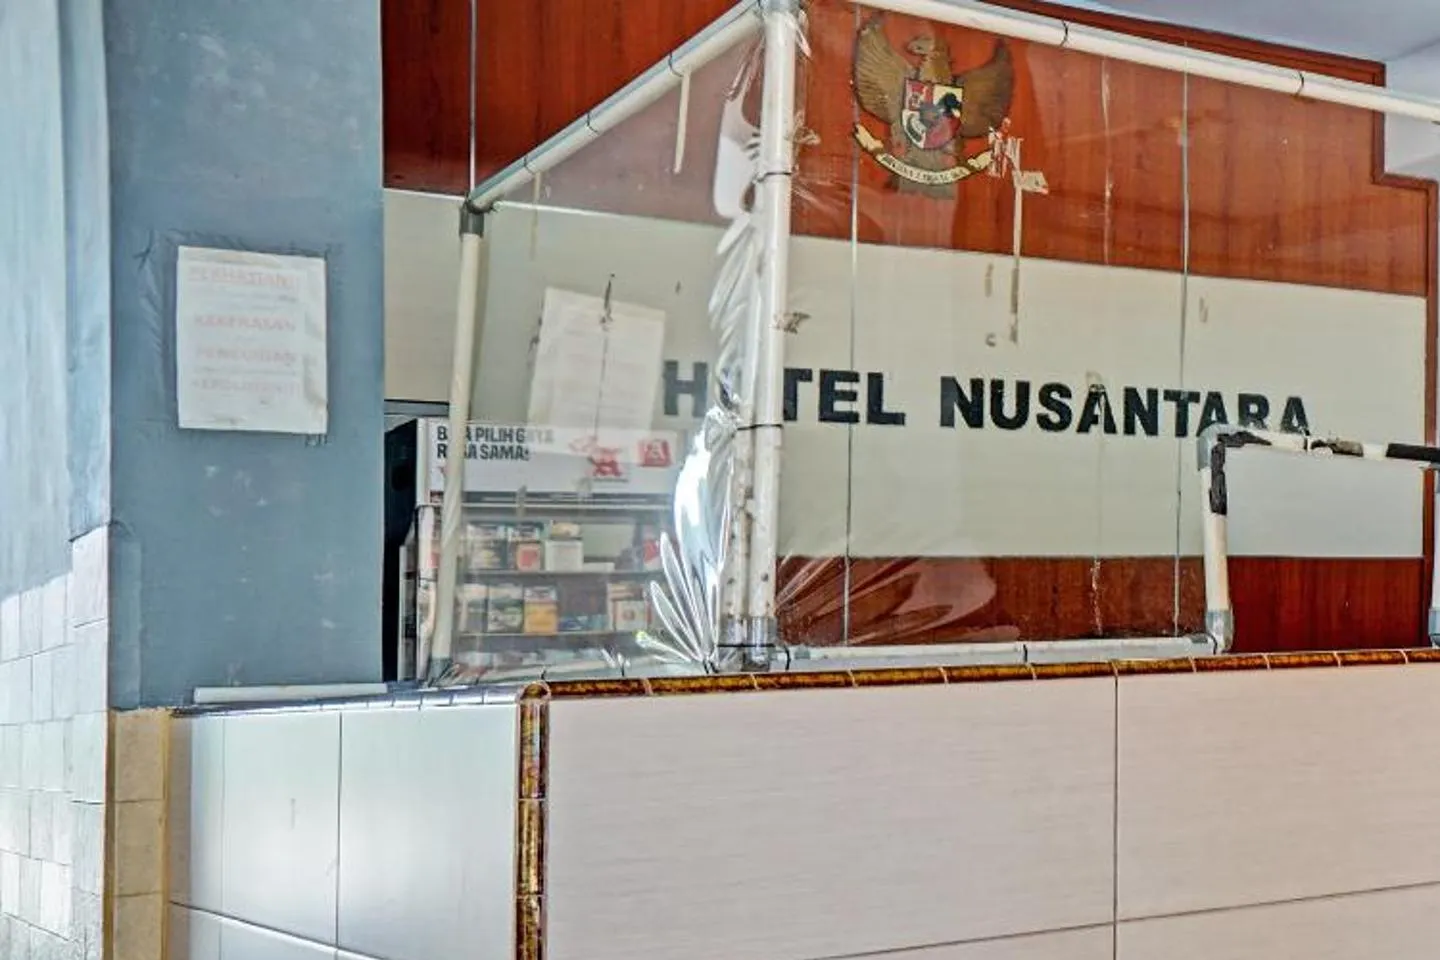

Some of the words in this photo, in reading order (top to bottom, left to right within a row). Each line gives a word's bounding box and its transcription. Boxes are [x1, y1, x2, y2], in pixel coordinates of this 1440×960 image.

[663, 360, 906, 426] HTEL
[940, 375, 1310, 437] NUSANTARA
[437, 425, 472, 441] BA
[475, 427, 513, 442] PILIH
